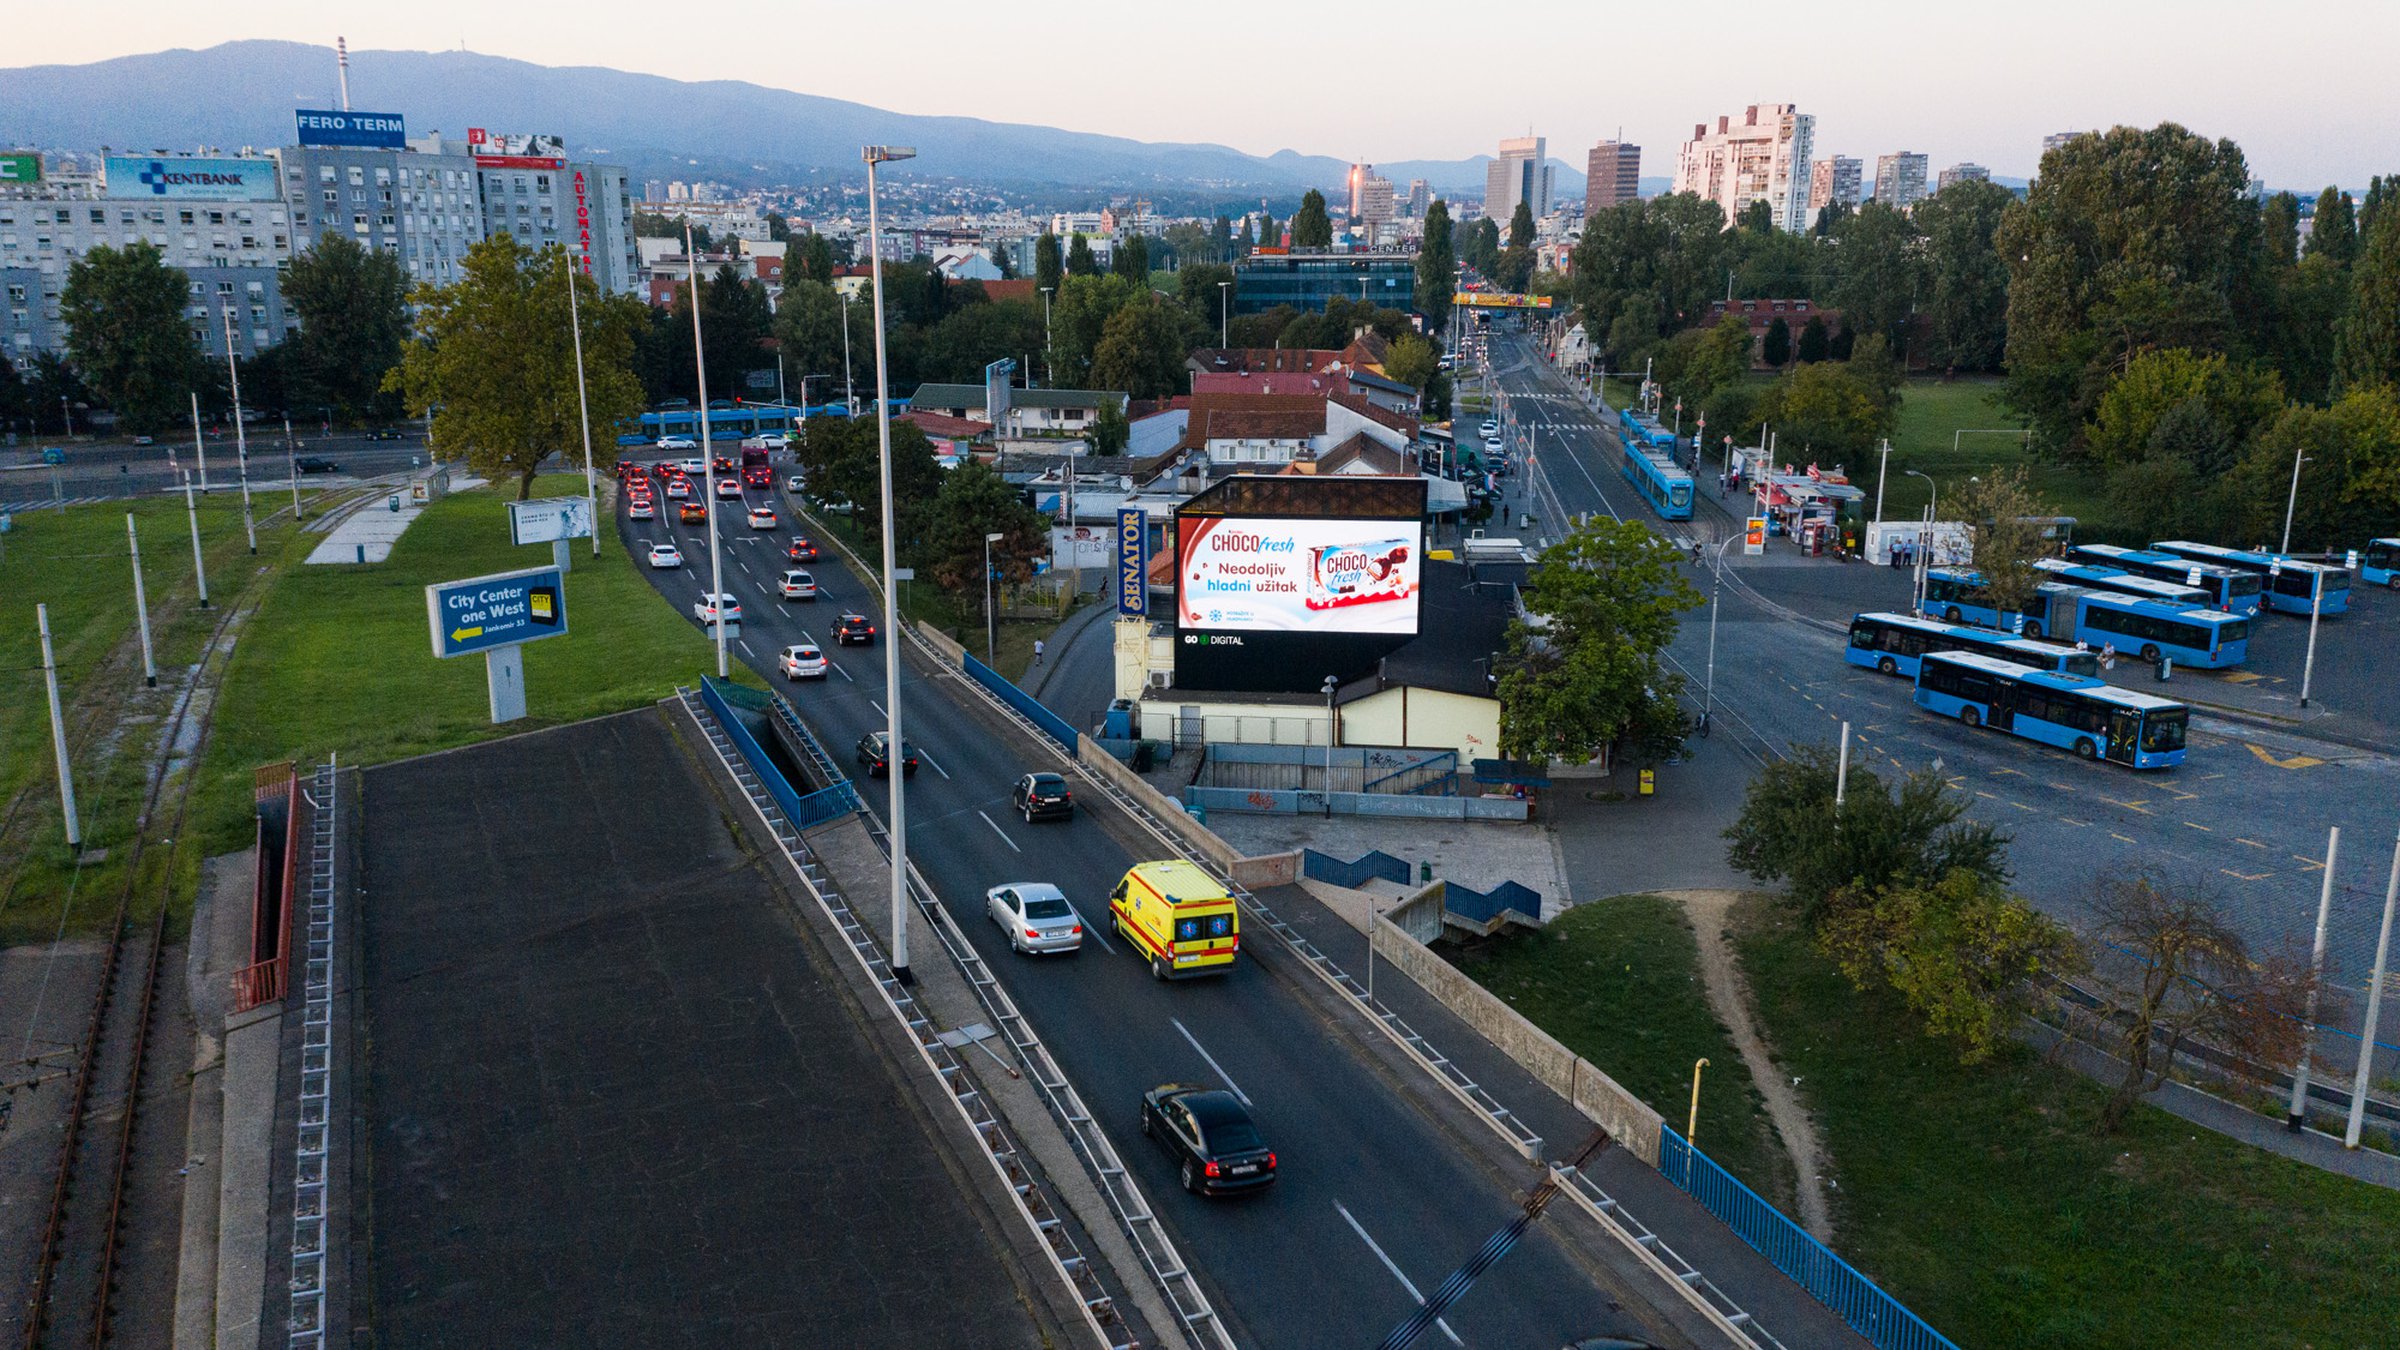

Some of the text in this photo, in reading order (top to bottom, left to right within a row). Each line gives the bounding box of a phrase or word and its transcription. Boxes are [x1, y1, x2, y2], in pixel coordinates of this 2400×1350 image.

[298, 116, 403, 132] FERO TERM
[163, 173, 243, 186] KENTBANK
[574, 171, 590, 252] AUTOMAT
[1370, 245, 1416, 253] CENTER
[1123, 511, 1142, 611] SENATOR
[1327, 554, 1367, 573] CHOCO
[1219, 562, 1286, 578] Neodoljiv
[1331, 568, 1361, 586] fresh
[1207, 579, 1297, 592] hladni užitak
[448, 587, 523, 609] City Center
[461, 610, 486, 623] one
[489, 601, 525, 619] West
[1185, 635, 1198, 643] GO
[1210, 635, 1244, 645] DIGITAL
